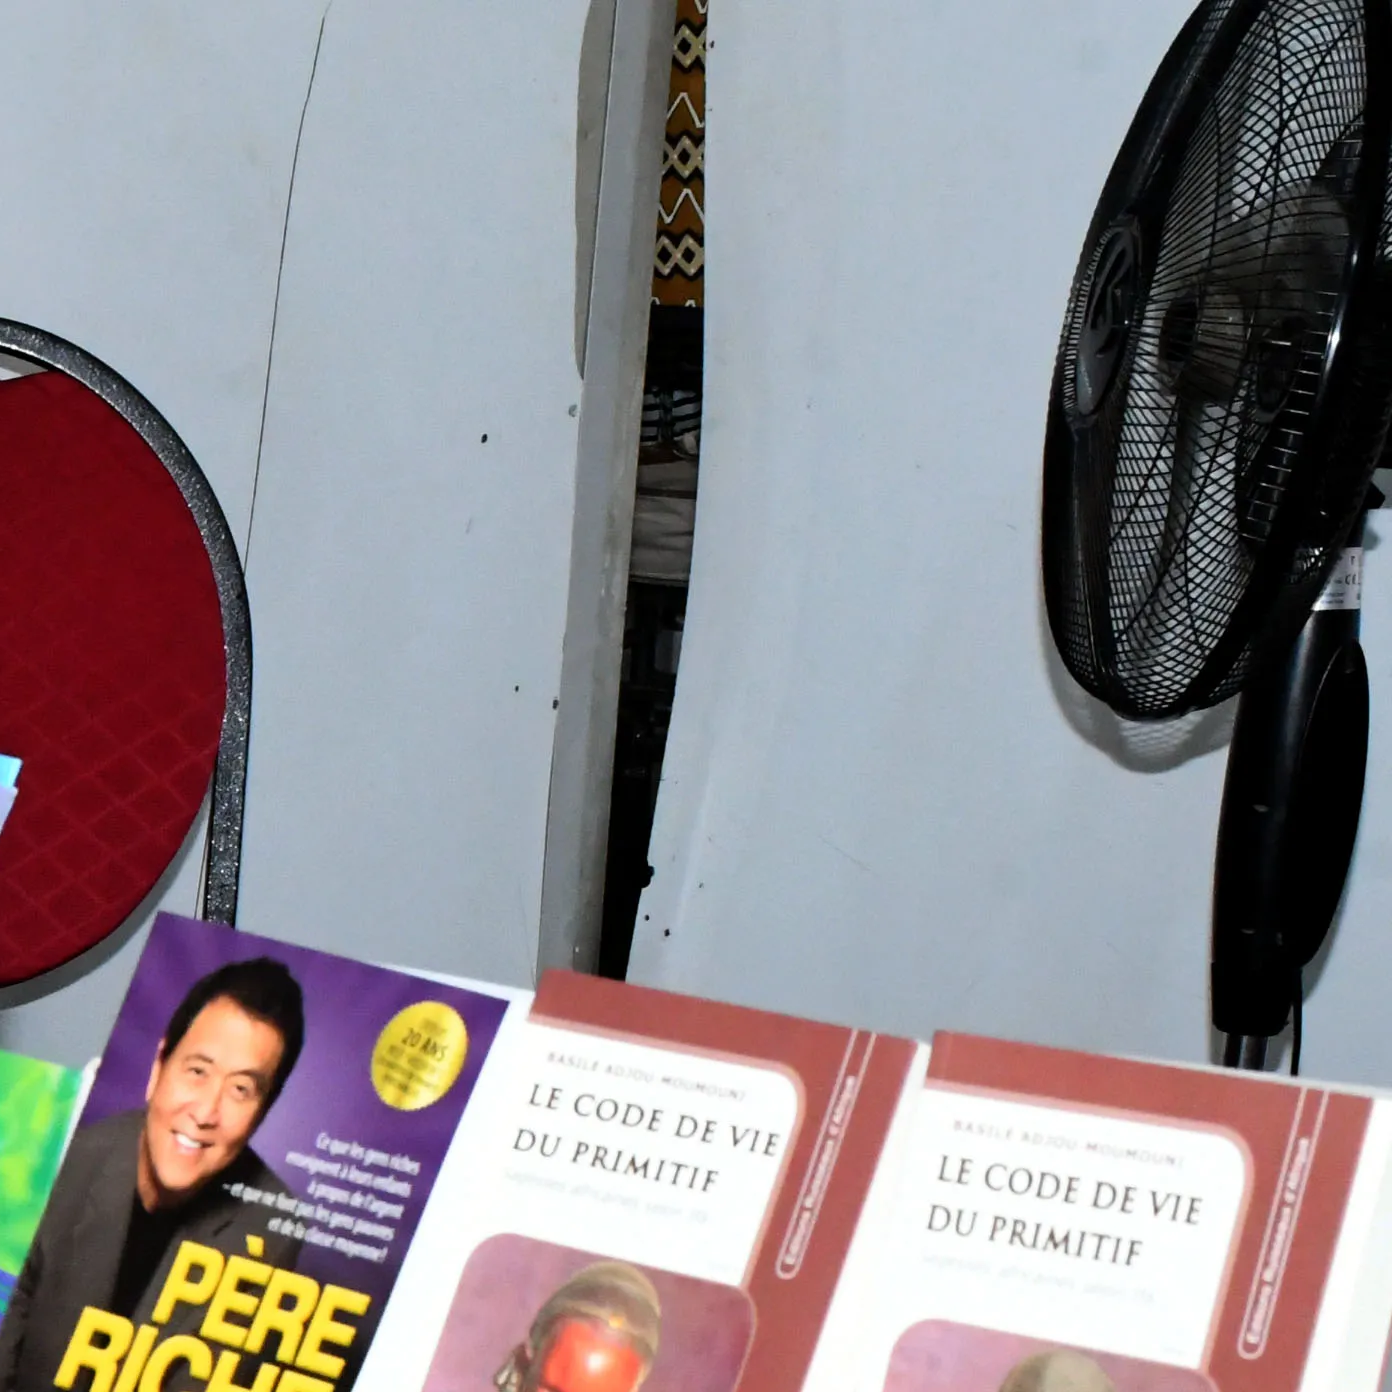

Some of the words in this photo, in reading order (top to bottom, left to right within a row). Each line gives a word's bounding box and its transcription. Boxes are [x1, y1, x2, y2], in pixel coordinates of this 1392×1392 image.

[528, 1083, 570, 1112] LE
[573, 1092, 665, 1134] CODE
[673, 1114, 717, 1144] DE
[729, 1125, 782, 1159] VIE
[512, 1128, 564, 1158] DU
[571, 1141, 721, 1194] PRIMITIF
[936, 1154, 974, 1187] LE
[983, 1161, 1082, 1206] CODE
[1092, 1180, 1139, 1215] DE
[1150, 1191, 1205, 1226] VIE
[926, 1203, 979, 1238] DU
[988, 1214, 1146, 1268] PRIMITIF
[152, 1236, 370, 1378] PÈRE
